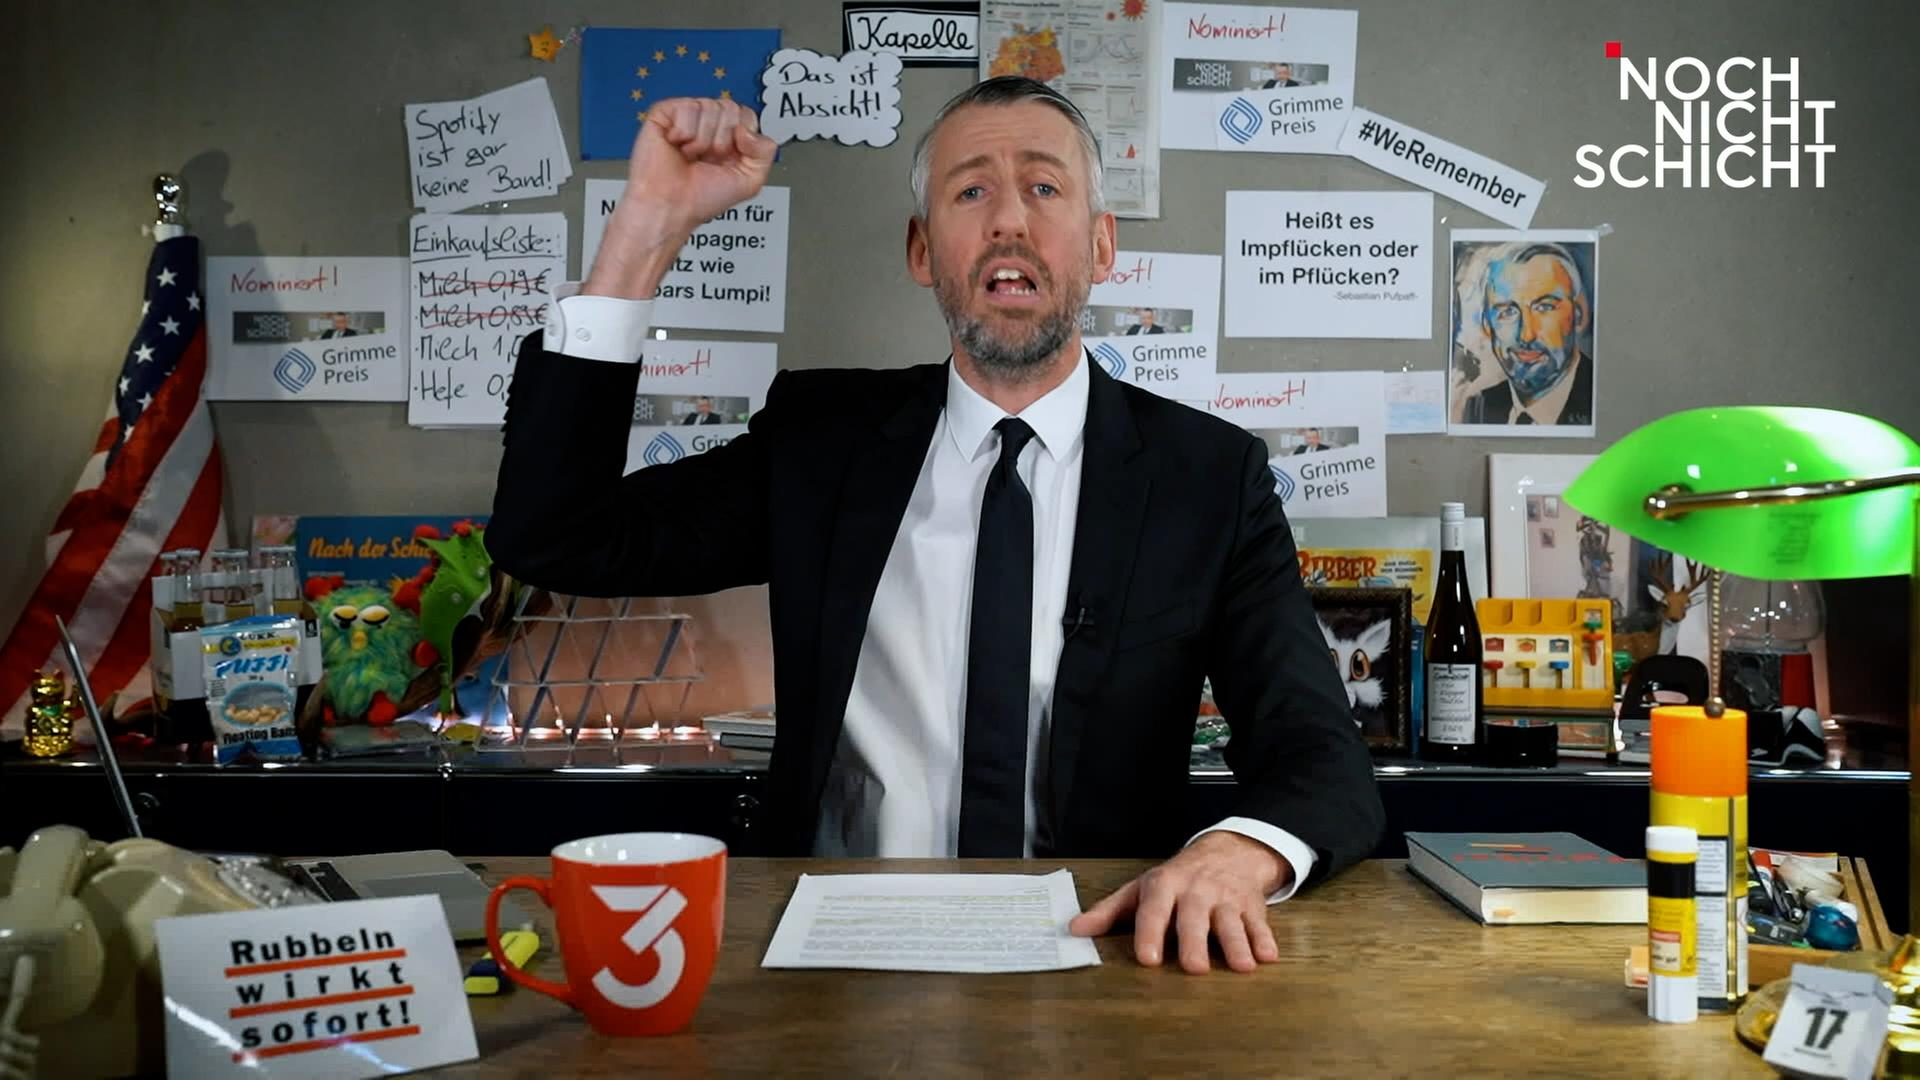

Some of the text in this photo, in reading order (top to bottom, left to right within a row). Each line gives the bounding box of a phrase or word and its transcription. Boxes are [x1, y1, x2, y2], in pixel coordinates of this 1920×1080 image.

[856, 16, 974, 53] Kapelle
[1188, 13, 1286, 42] Nominiert!
[779, 61, 878, 86] Das ist
[779, 89, 881, 120] Absicht!
[1268, 97, 1343, 116] Grimme
[416, 105, 501, 142] Spotify
[1270, 119, 1316, 136] Preis
[418, 143, 508, 168] ist gar
[1358, 119, 1527, 208] #WeRemember
[416, 158, 552, 198] keine Band!
[745, 205, 774, 222] für
[1285, 211, 1374, 230] Heißt es
[413, 225, 552, 261] Einkaufsliste:
[1241, 239, 1419, 260] Impflücken oder
[700, 257, 735, 274] wie
[1259, 267, 1400, 285] im Pflücken?
[231, 265, 339, 295] Nominiert!
[419, 267, 477, 298] Milch
[701, 282, 771, 305] Lumpi!
[420, 302, 484, 330] Milch
[322, 345, 397, 366] Grimme
[420, 335, 478, 361] Milch
[1132, 344, 1207, 362] Grimme
[324, 366, 369, 385] Preis
[1134, 364, 1179, 382] Preis
[420, 367, 469, 409] Hefe
[1300, 456, 1376, 480] Grimme
[1304, 479, 1350, 500] Preis
[308, 536, 354, 559] Nach
[358, 536, 387, 559] der
[231, 928, 395, 965] Rubbeln
[591, 884, 689, 1009] 3
[236, 962, 405, 1005] wirkt
[241, 1000, 410, 1048] sofort!
[1805, 1007, 1849, 1050] 17
